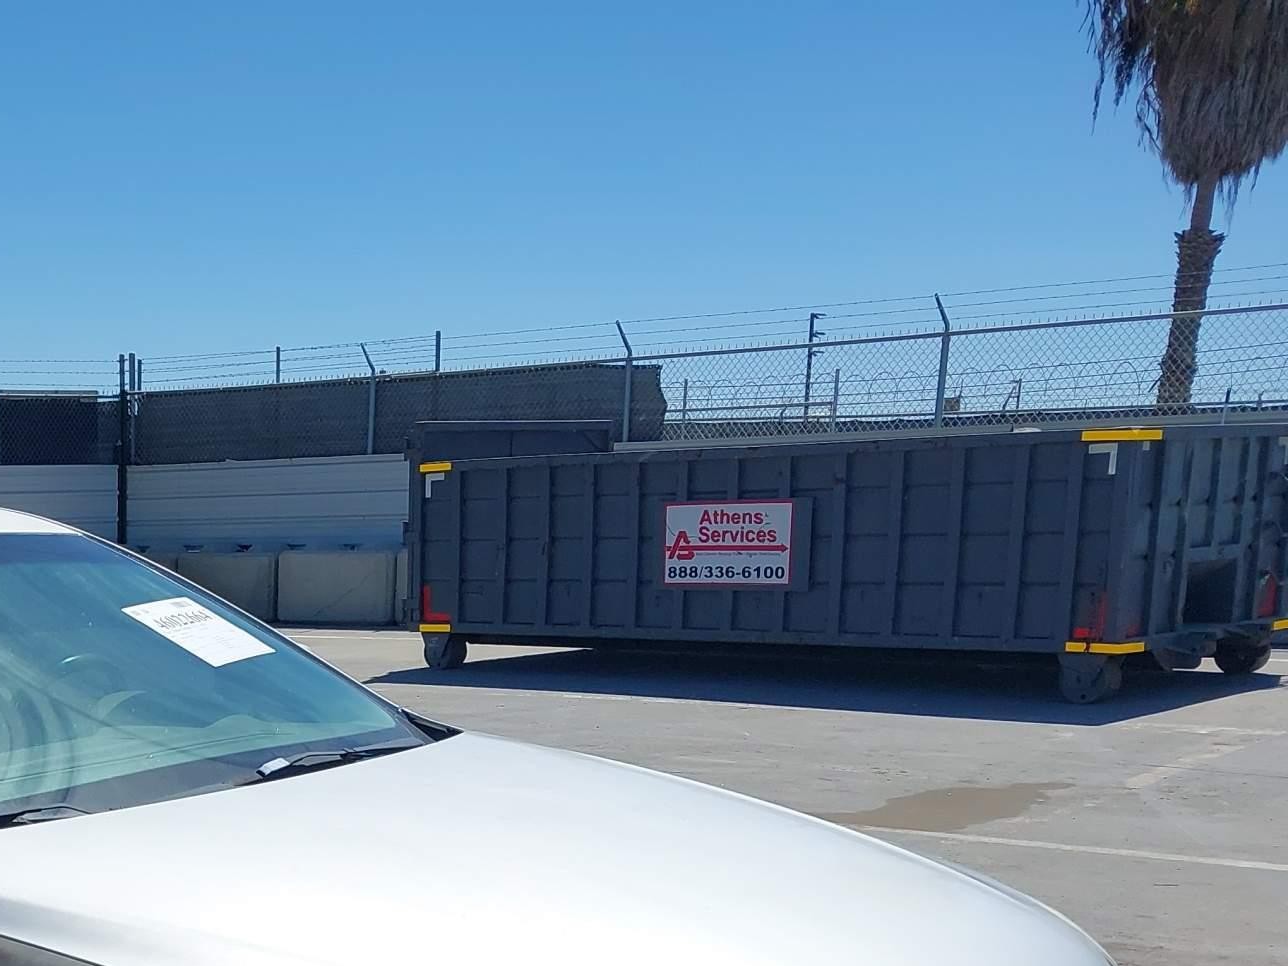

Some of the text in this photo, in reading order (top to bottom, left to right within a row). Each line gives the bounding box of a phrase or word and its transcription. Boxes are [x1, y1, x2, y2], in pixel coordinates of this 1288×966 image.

[699, 509, 764, 525] Athens
[698, 526, 777, 543] Services
[668, 566, 785, 579] 888/336-6100
